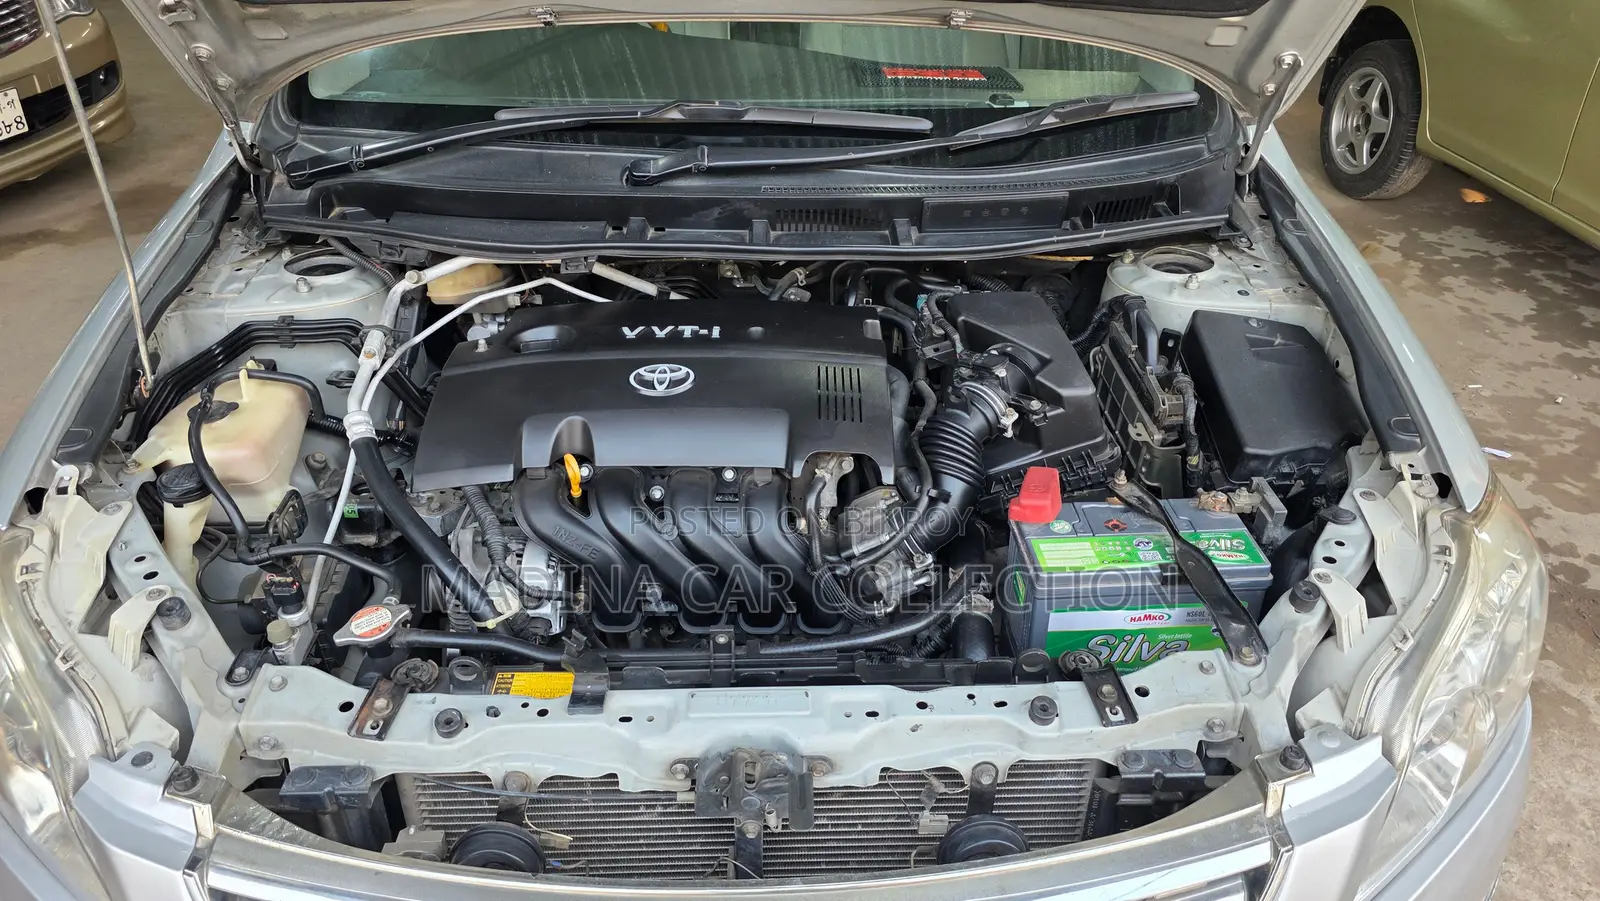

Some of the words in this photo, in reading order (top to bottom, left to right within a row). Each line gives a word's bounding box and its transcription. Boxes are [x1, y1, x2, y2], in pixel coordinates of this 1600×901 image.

[551, 525, 601, 560] 1NZ-FE
[1129, 613, 1165, 623] HAMKO
[1087, 633, 1191, 663] Silva
